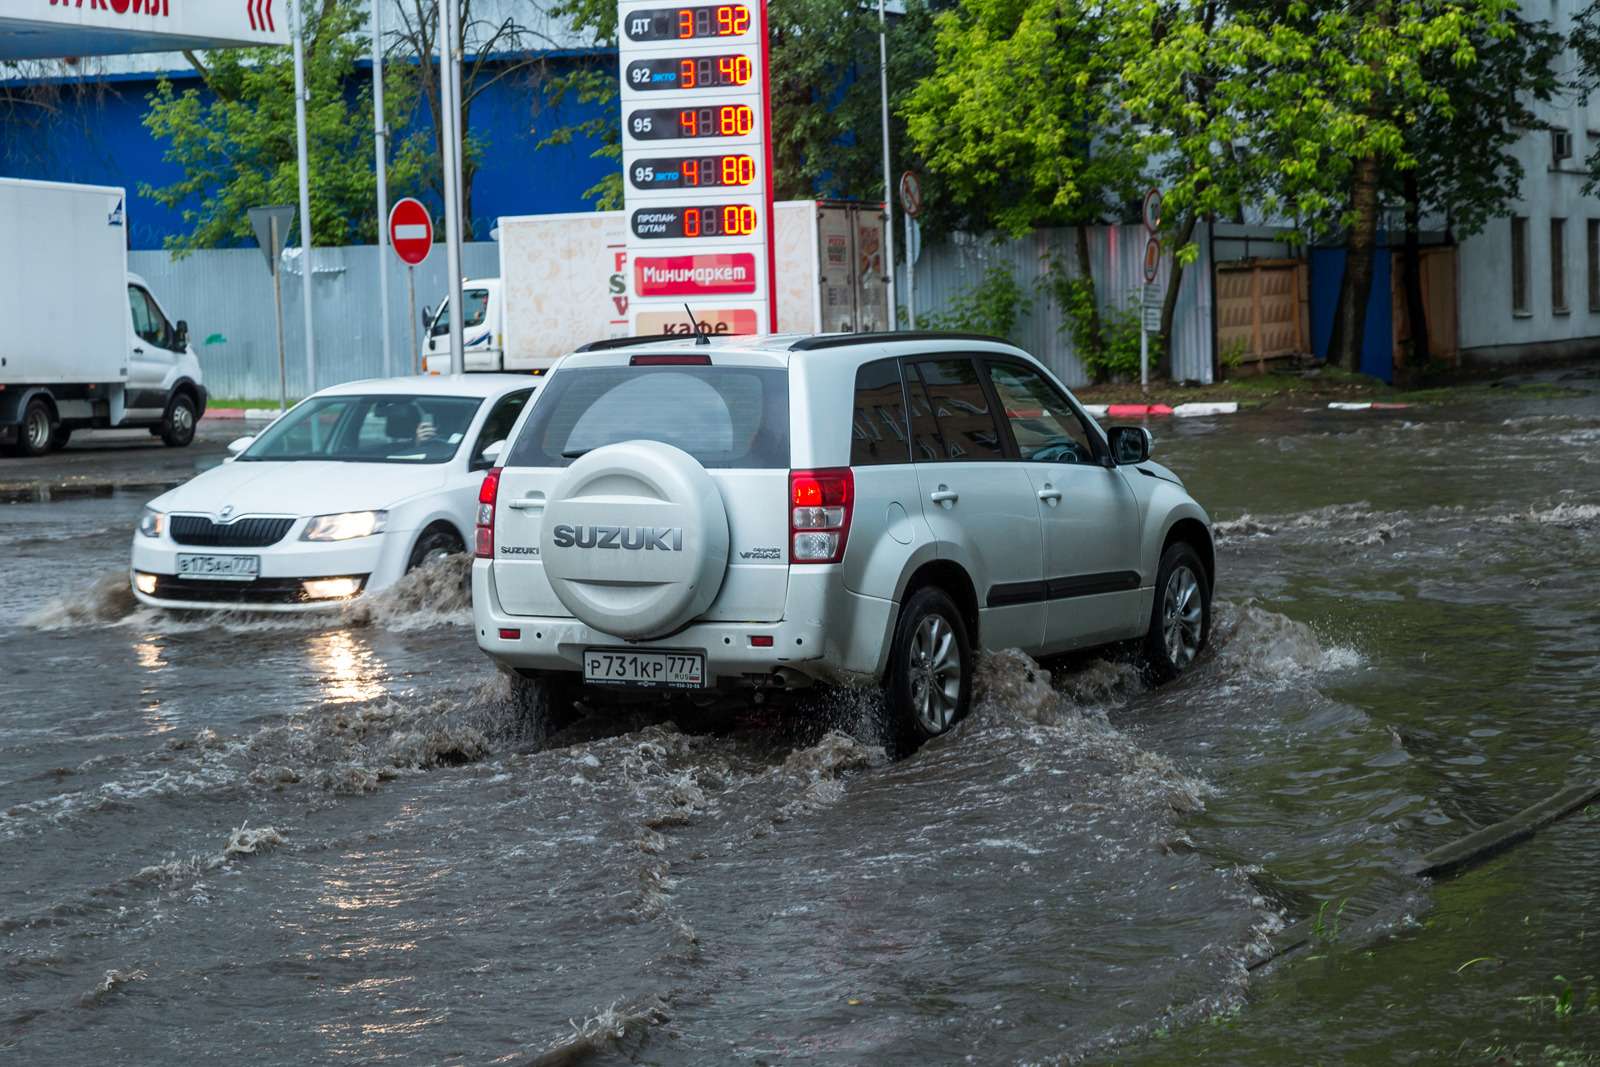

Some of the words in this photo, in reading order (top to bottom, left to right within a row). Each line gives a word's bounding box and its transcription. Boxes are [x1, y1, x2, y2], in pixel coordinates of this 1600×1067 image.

[631, 18, 650, 35] ДТ
[632, 68, 650, 83] 92
[633, 118, 652, 132] 95
[635, 167, 653, 182] 95
[637, 223, 667, 233] БУТАН
[643, 265, 746, 286] Минимаркет
[553, 524, 683, 552] SUZUKI
[500, 545, 539, 555] SUZUKI
